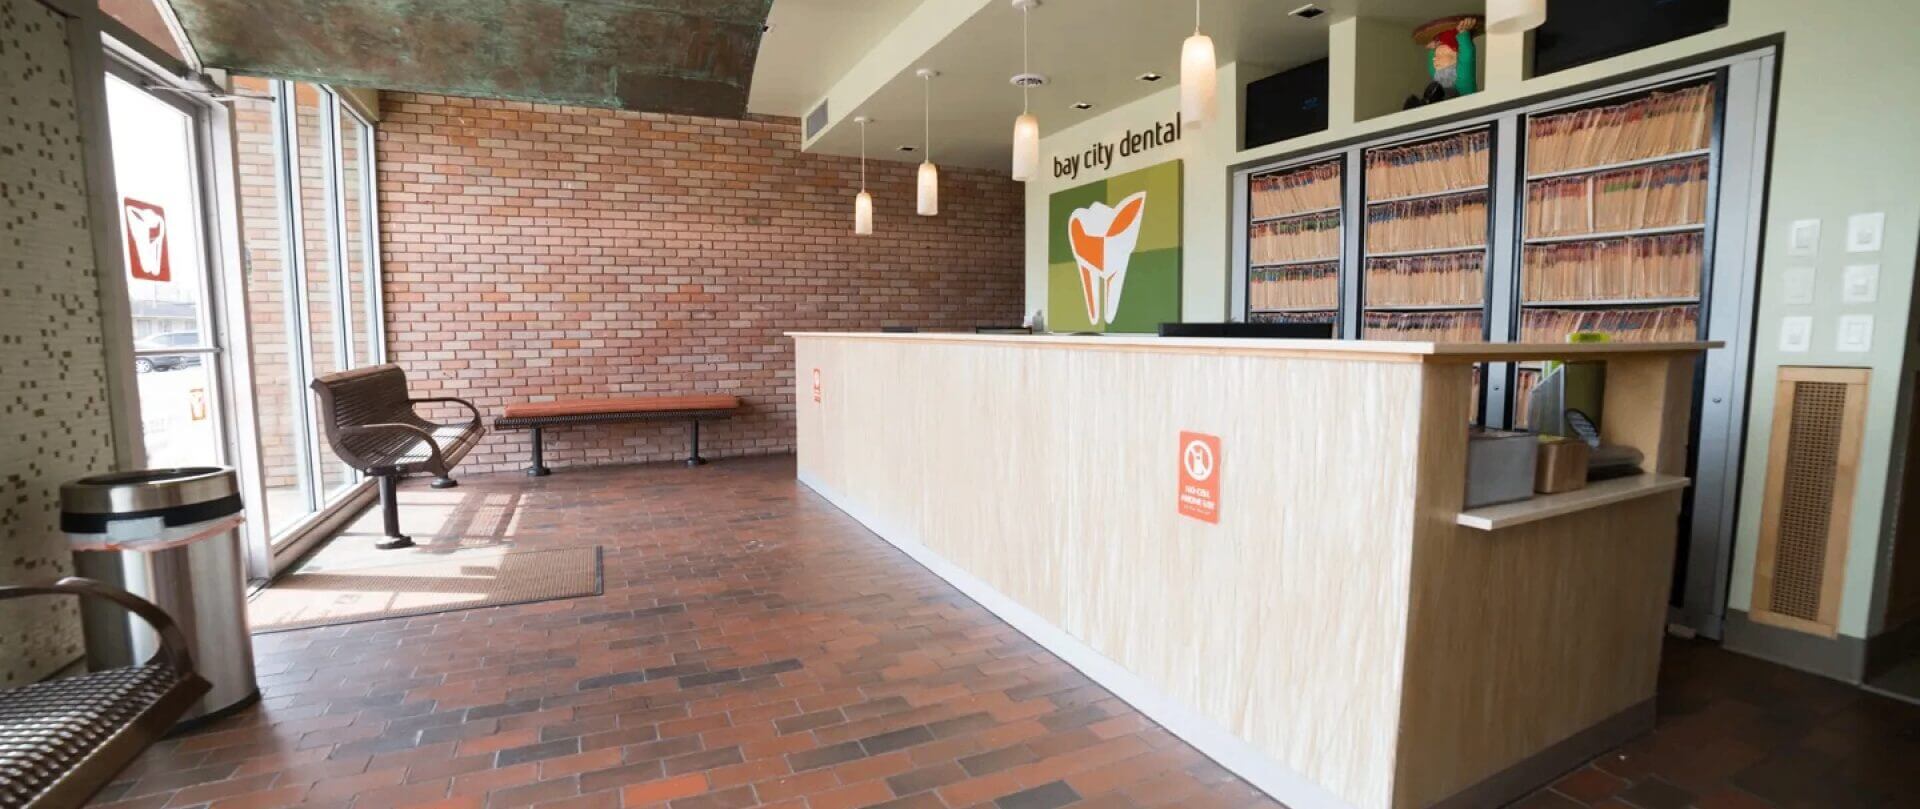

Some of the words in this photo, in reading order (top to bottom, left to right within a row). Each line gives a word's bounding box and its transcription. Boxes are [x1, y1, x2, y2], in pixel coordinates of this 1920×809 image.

[1053, 155, 1080, 180] bay
[1084, 142, 1114, 170] city
[1119, 111, 1181, 157] dental
